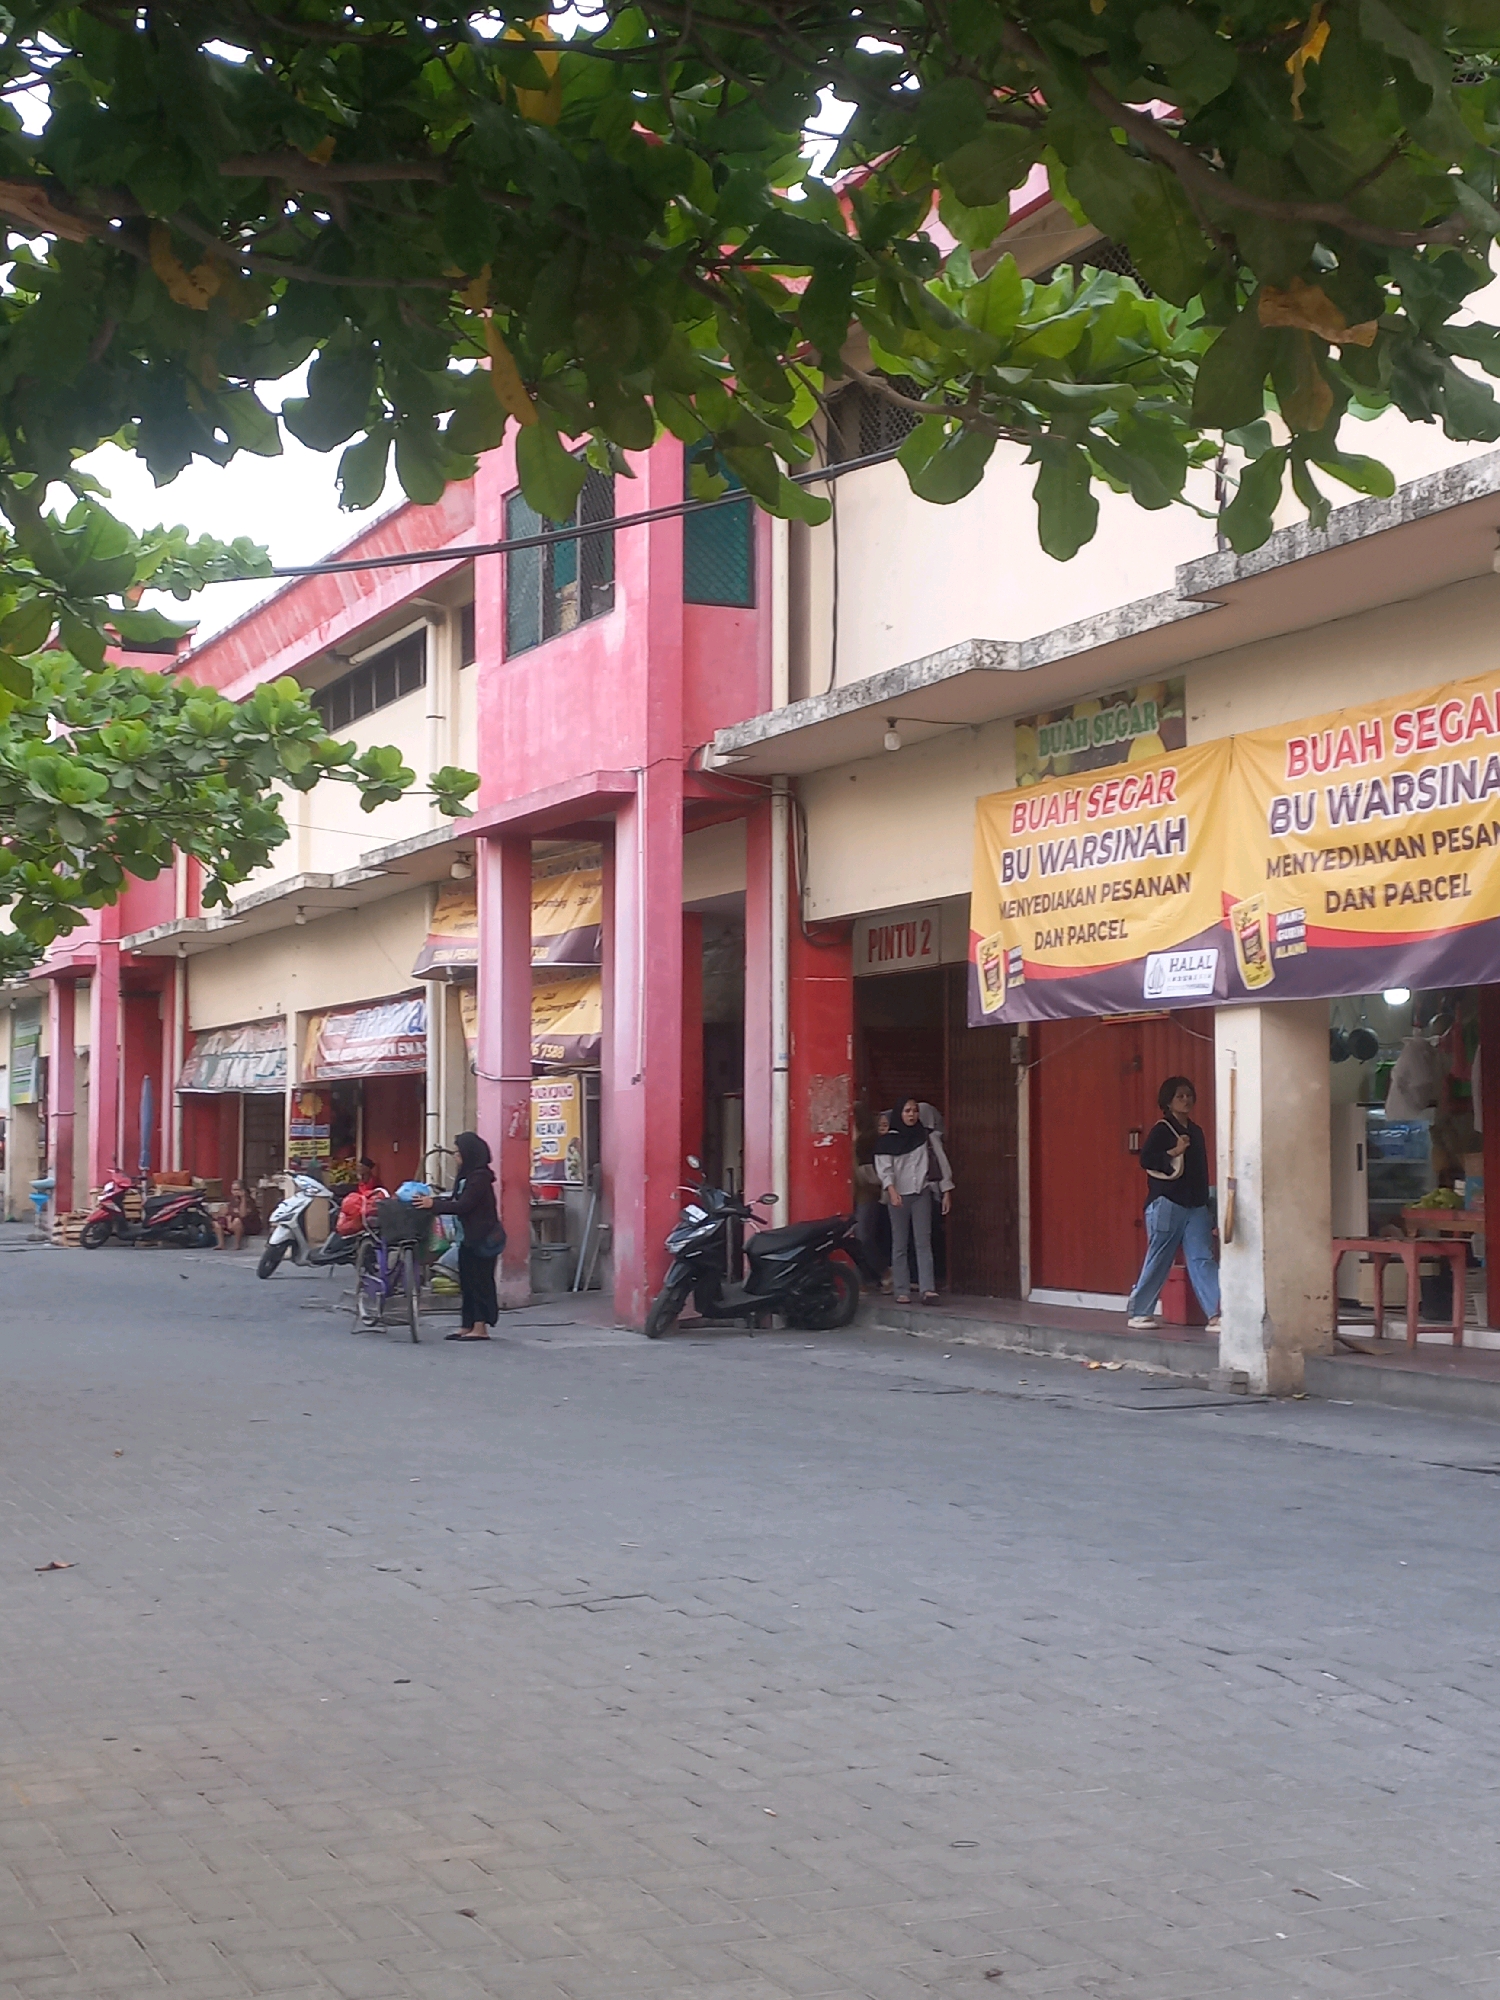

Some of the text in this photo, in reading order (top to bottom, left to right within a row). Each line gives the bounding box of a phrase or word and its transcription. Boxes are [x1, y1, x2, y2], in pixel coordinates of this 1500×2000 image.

[1038, 701, 1157, 757] BUAH SEGAR
[1286, 690, 1500, 778] BUAH SEGA
[1012, 768, 1176, 833] BUAH SEGAR
[1270, 792, 1316, 834] BU
[1002, 817, 1187, 883] BU WARSINAH
[1266, 833, 1425, 879] MENYEDIAKAN
[1101, 872, 1191, 903] PESANAN
[1325, 873, 1472, 913] DAN PARCEL
[868, 919, 931, 963] PINTU 2
[1034, 919, 1129, 950] DAN PARCEL
[1169, 955, 1213, 972] HALAL
